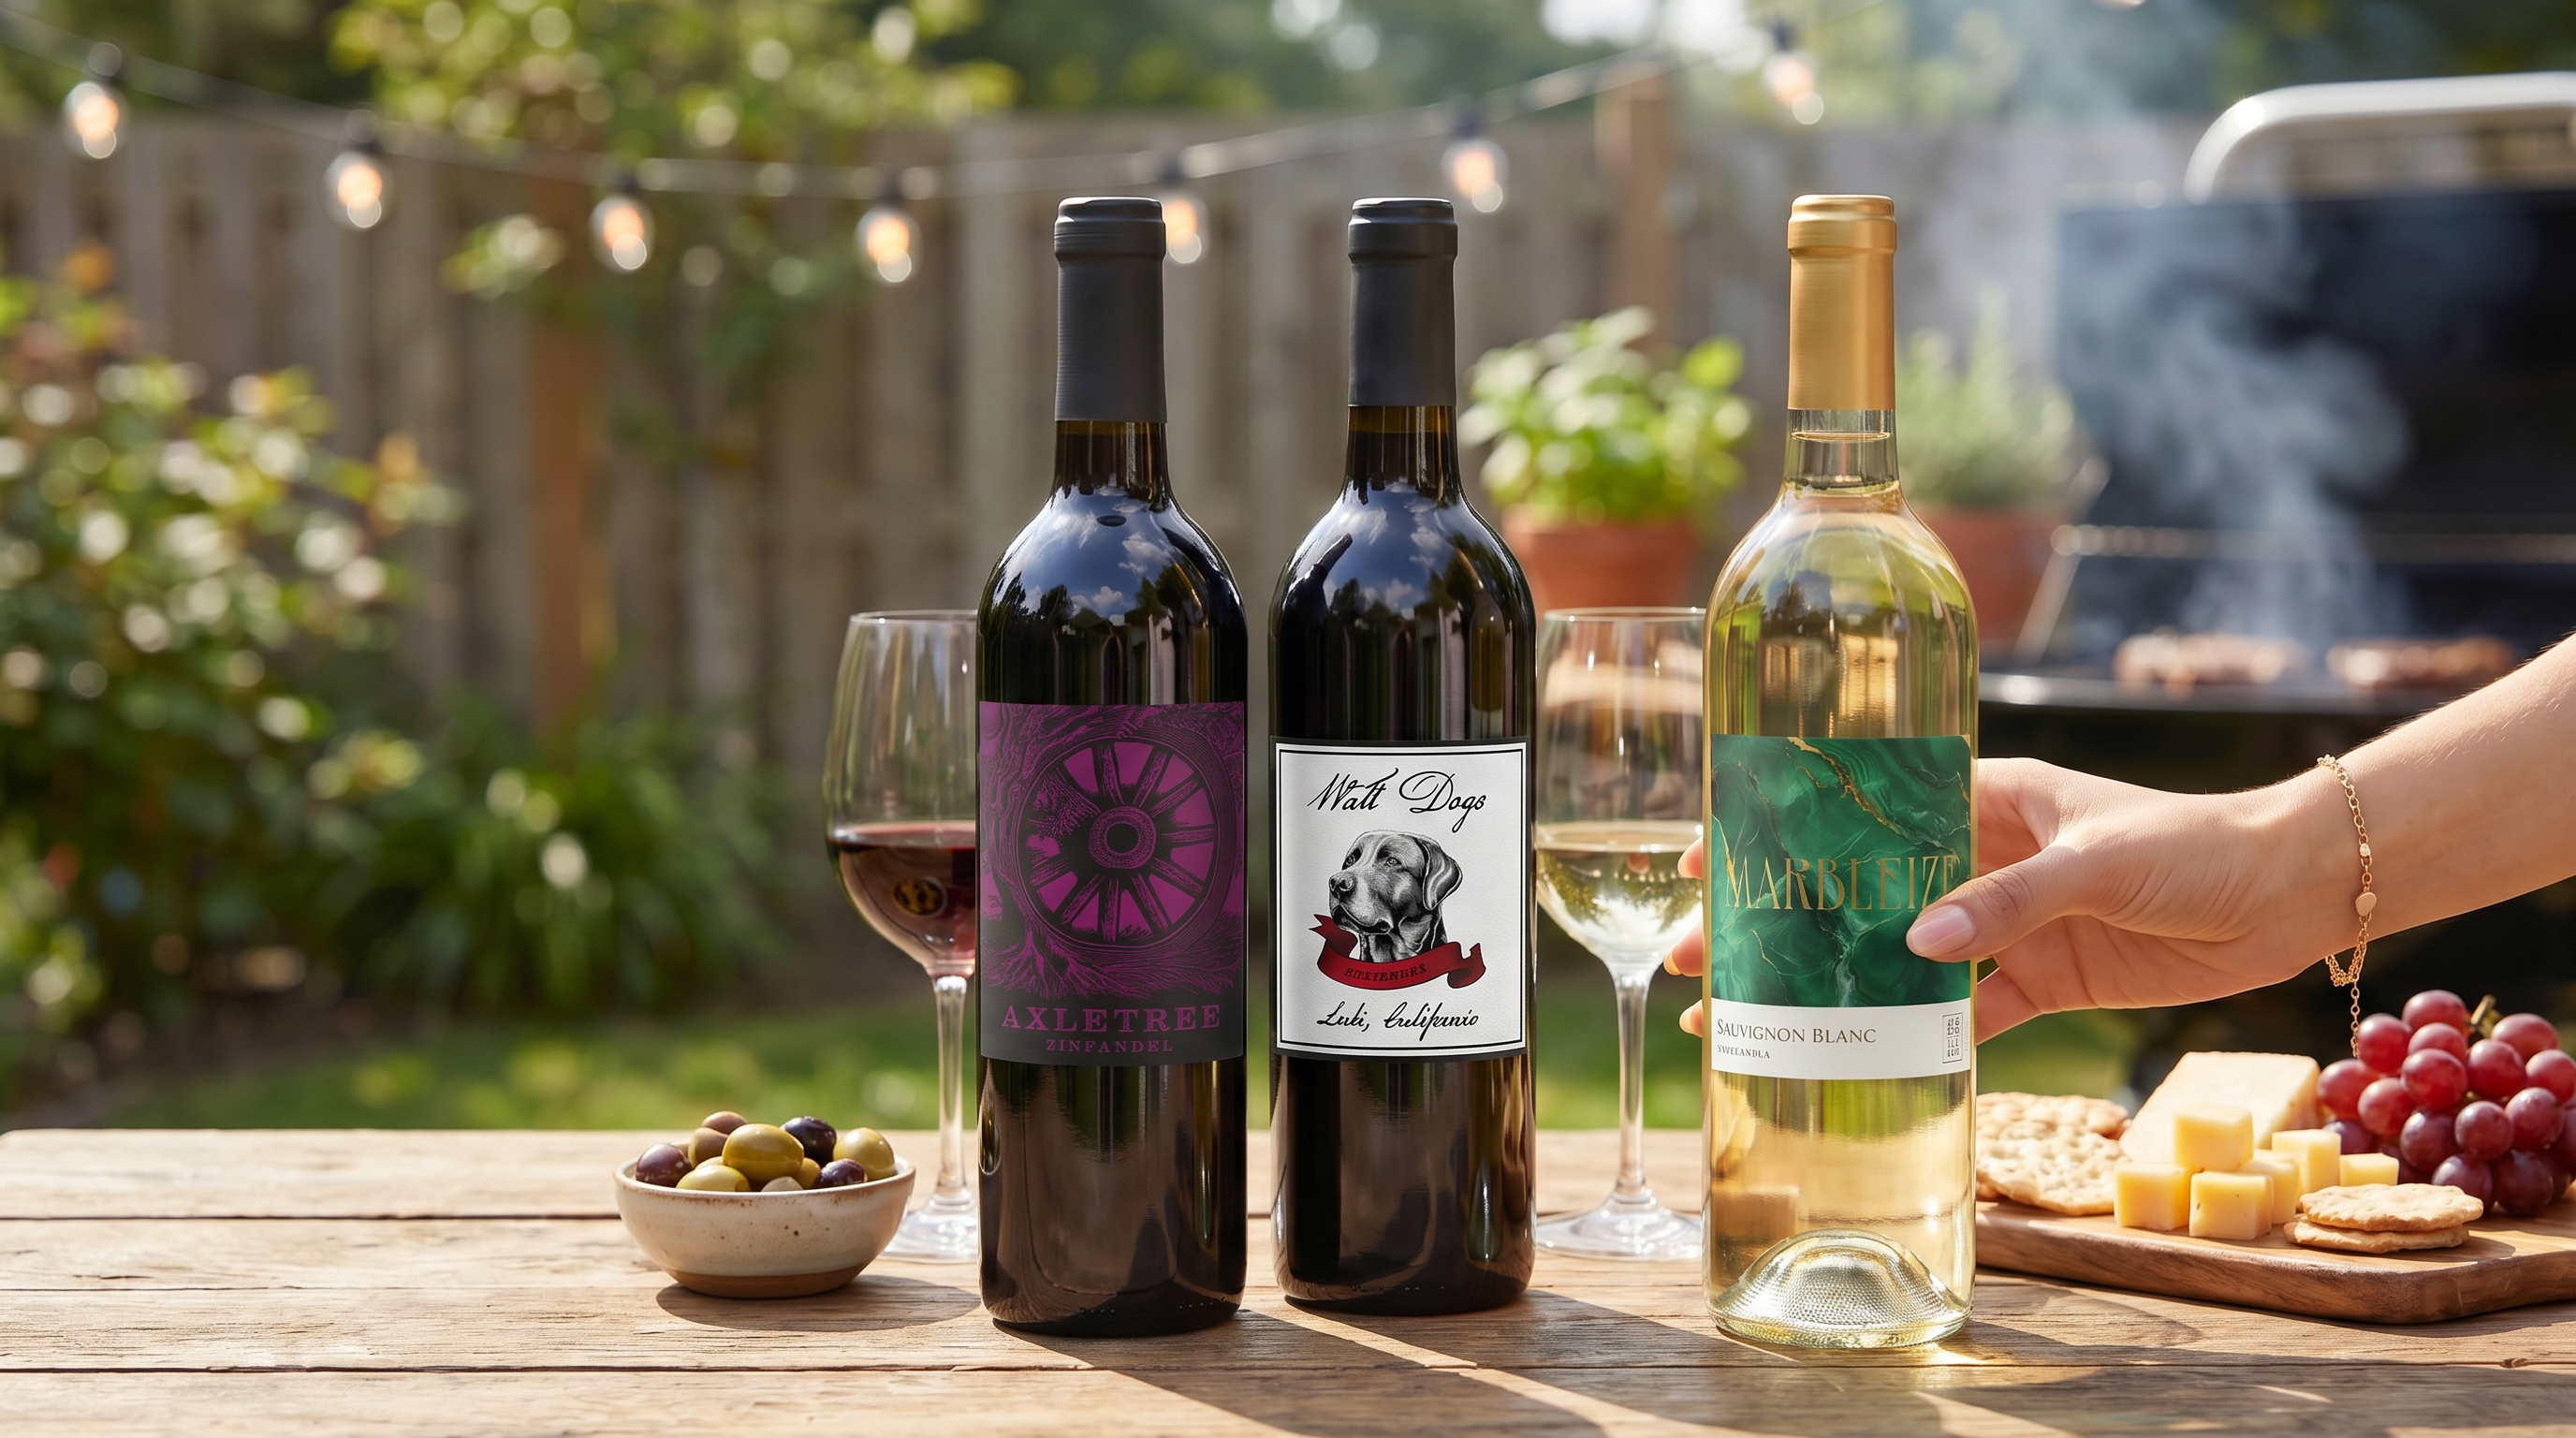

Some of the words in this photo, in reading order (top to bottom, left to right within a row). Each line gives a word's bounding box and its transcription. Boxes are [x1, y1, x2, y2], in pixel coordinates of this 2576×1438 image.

[1399, 770, 1486, 833] Dogs
[1001, 1004, 1221, 1033] AXLETREE
[1046, 1038, 1174, 1053] ZINFANDEL
